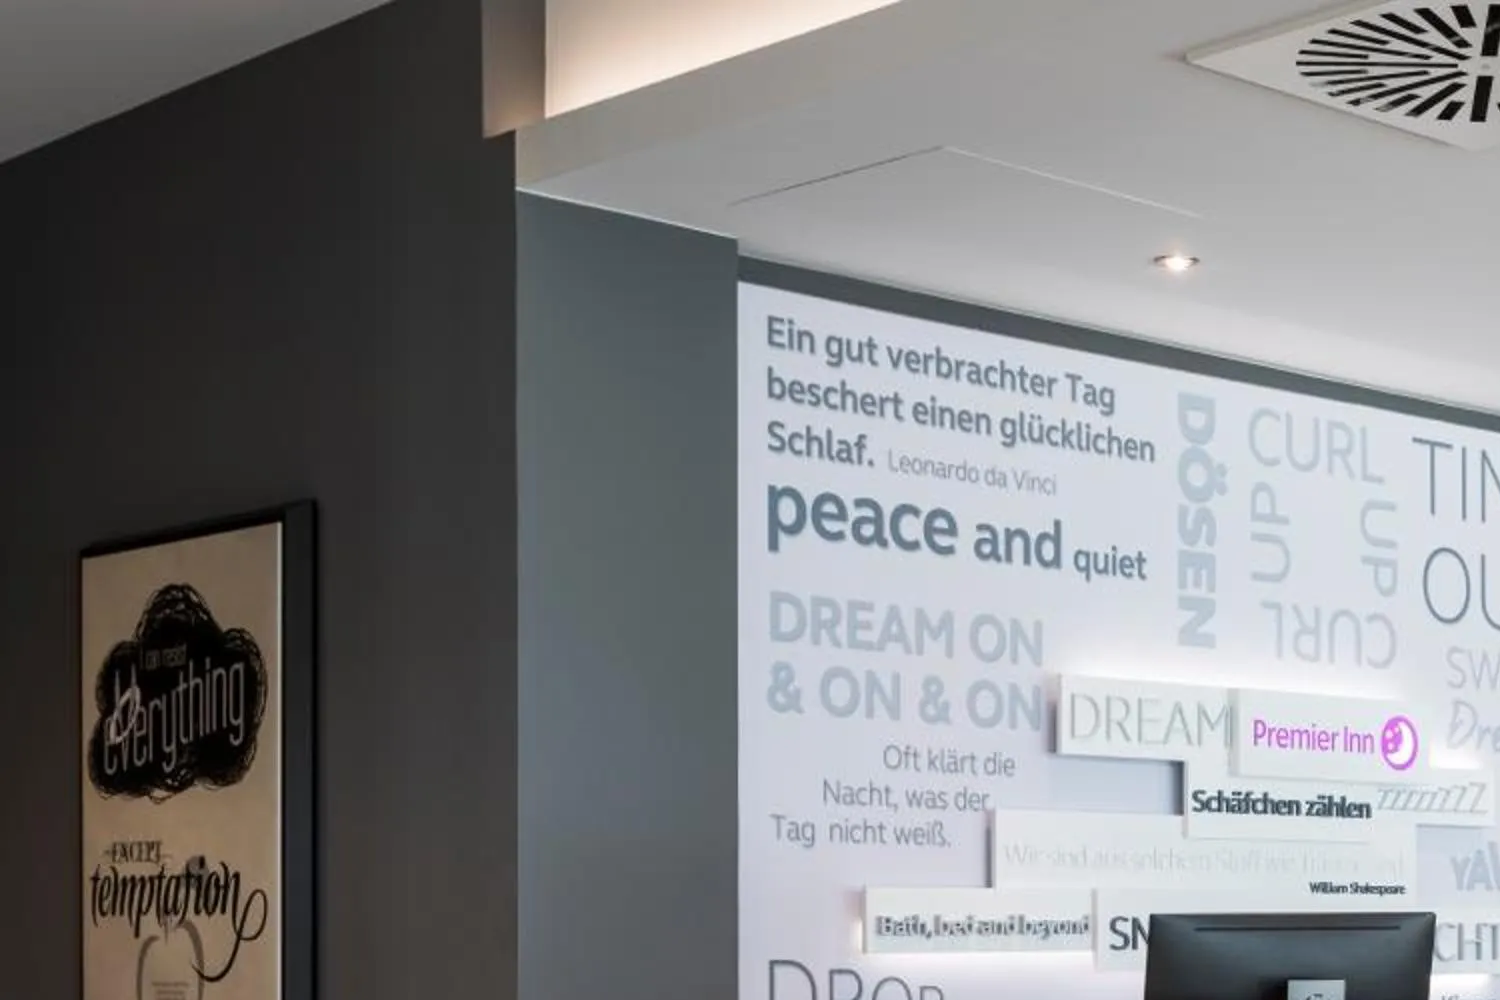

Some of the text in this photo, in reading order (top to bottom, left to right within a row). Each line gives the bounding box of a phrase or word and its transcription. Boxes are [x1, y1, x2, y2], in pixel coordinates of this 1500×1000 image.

[767, 315, 1116, 416] Ein gut verbrachter Tag
[767, 367, 1156, 462] beschert einen glücklichen
[1248, 407, 1385, 485] CURL
[767, 421, 1057, 496] Schlaf. Leonardo da Vinci
[767, 484, 1147, 583] peace and quiet
[1177, 391, 1228, 650] DÖSEN
[1250, 481, 1291, 584] UP
[1360, 499, 1399, 598] UP
[768, 590, 1044, 667] DREAM ON
[1260, 601, 1398, 670] CURL
[103, 655, 246, 776] everything
[766, 660, 1042, 731] & ON & ON
[883, 742, 1017, 778] Oft klärt die
[1253, 719, 1375, 755] Premier Inn
[769, 814, 952, 848] Tag nicht weiß.
[822, 779, 990, 813] Nacht, was der
[1191, 789, 1373, 820] Schäfchen zählen
[90, 855, 268, 983] temptation
